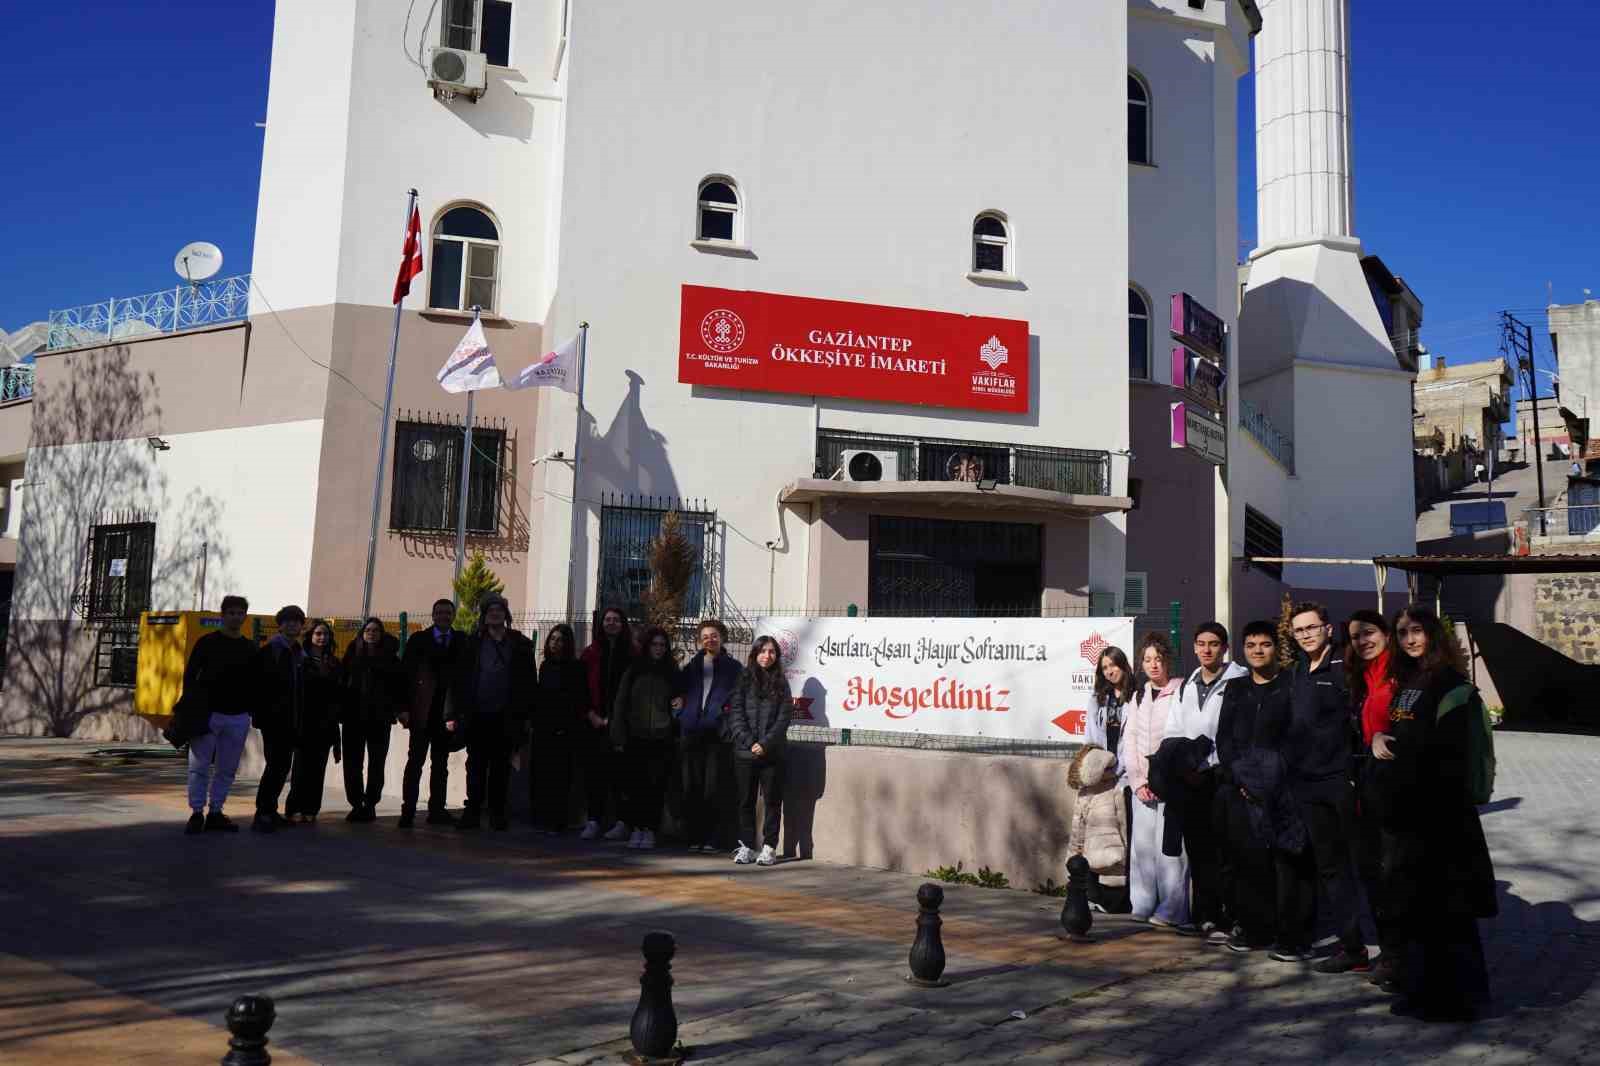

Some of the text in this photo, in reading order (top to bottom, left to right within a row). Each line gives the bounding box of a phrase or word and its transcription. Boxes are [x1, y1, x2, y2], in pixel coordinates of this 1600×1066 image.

[809, 330, 912, 352] GAZİANTEP
[771, 344, 946, 375] ÖKKEŞİYE İMARETİ
[972, 375, 1016, 388] VAKIFLAR
[818, 634, 1047, 669] Asırları Aşan Hayır Soframıza
[843, 676, 1011, 719] Hoşgeldiniz
